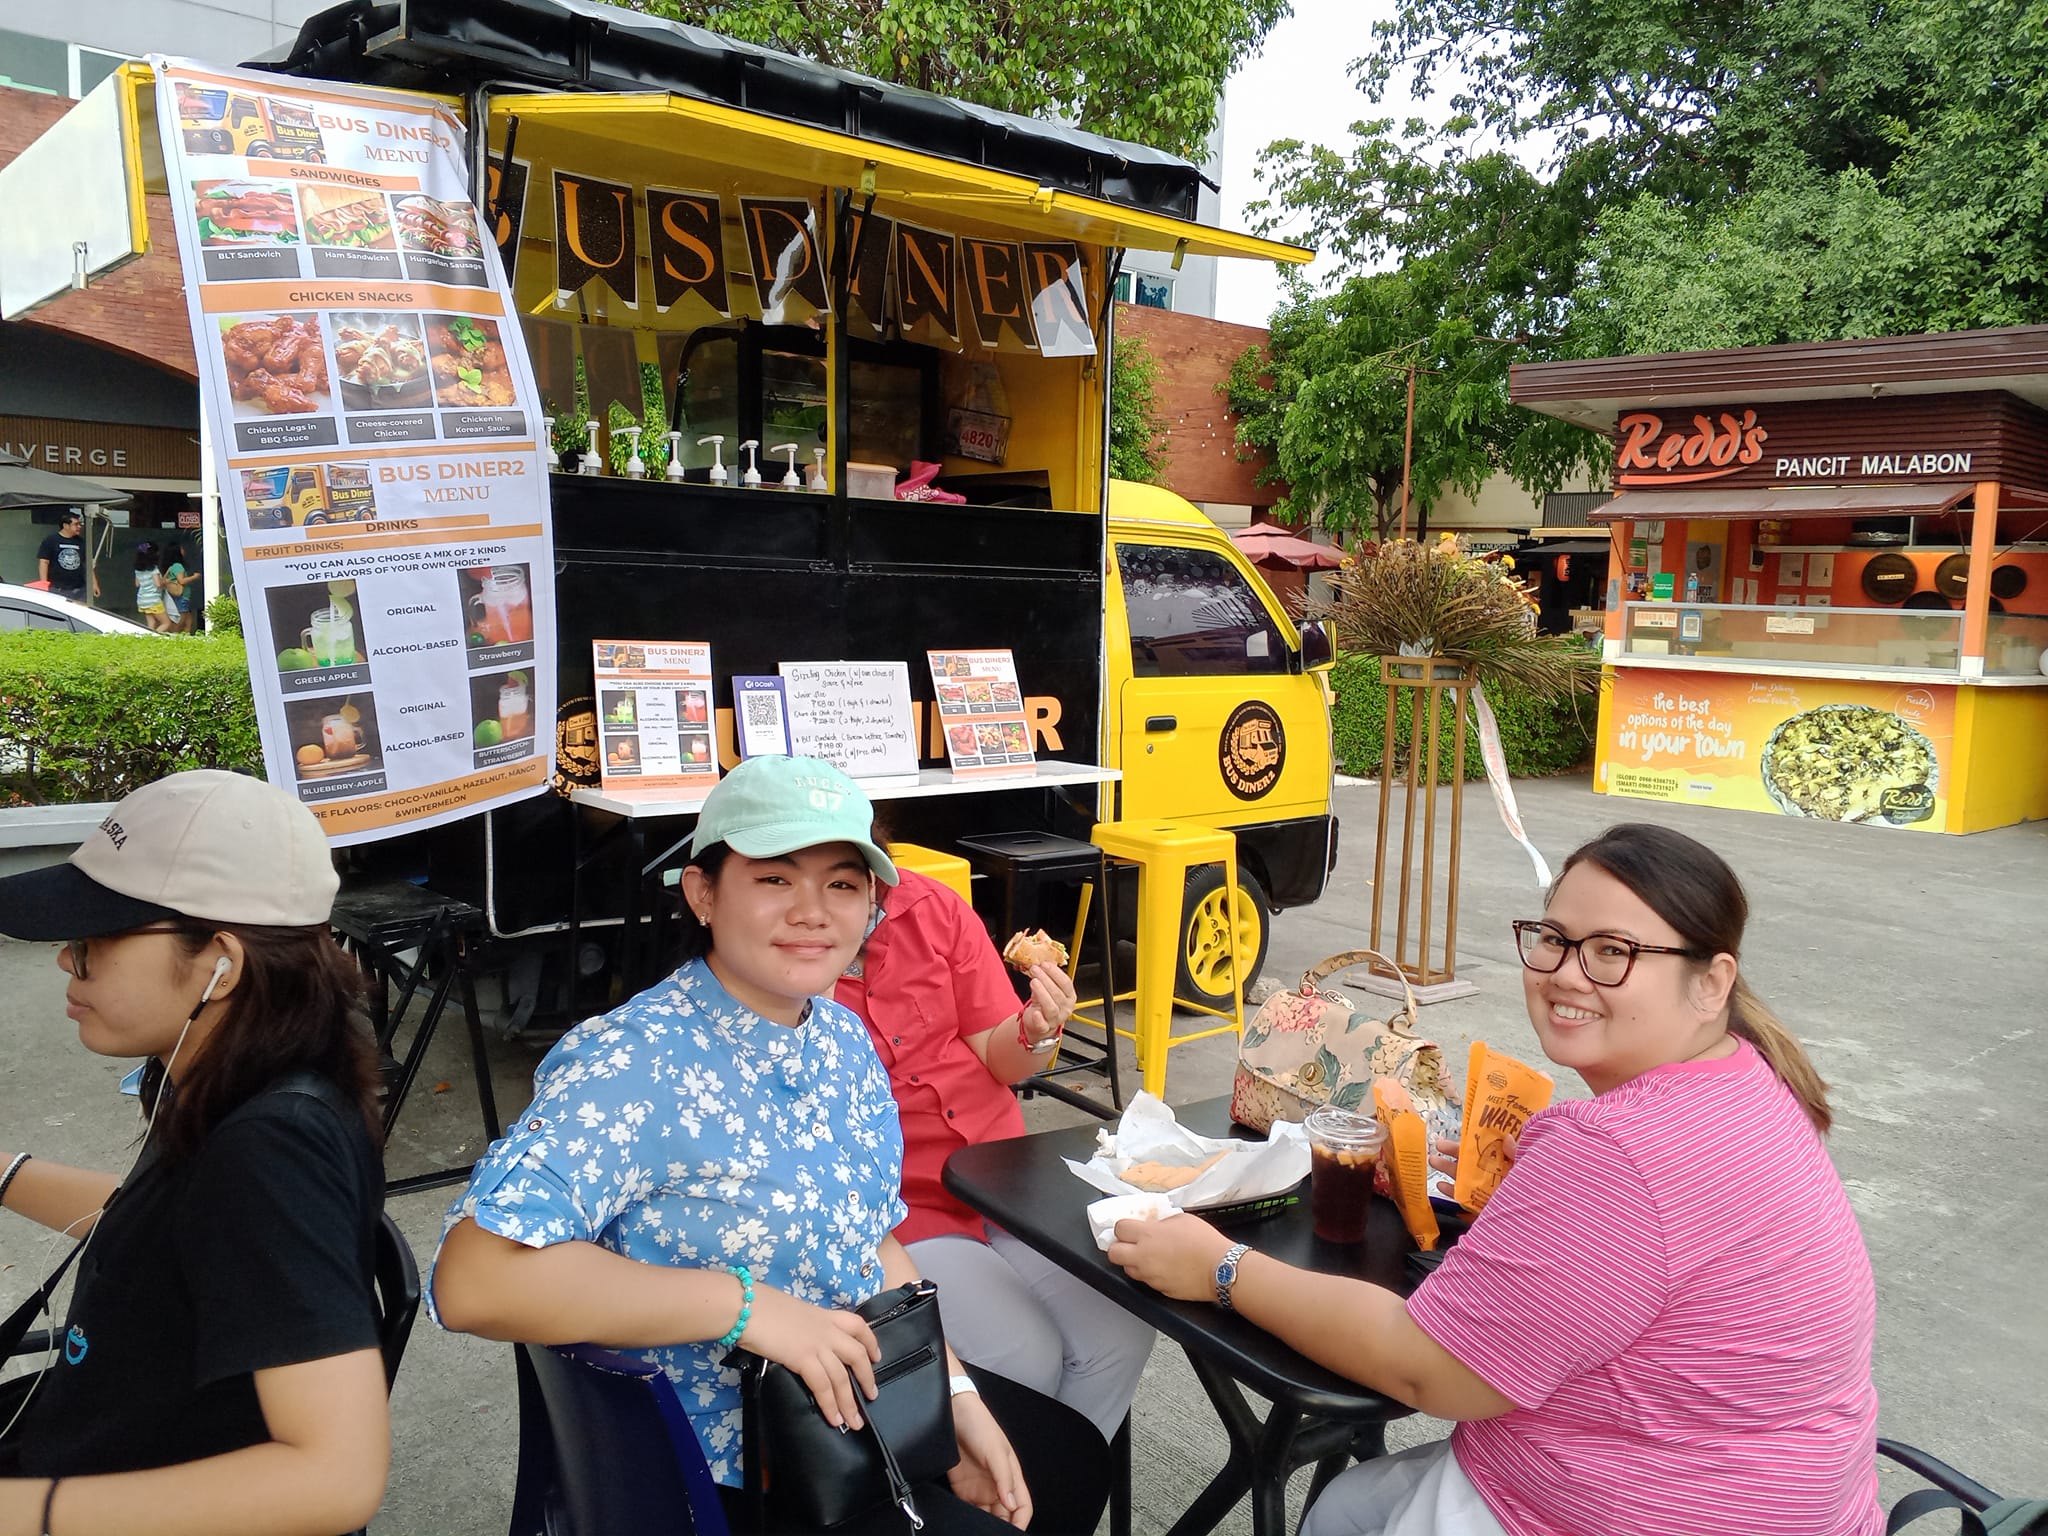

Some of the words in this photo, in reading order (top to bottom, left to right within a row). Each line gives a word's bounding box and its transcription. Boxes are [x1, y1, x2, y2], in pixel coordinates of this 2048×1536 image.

[276, 125, 295, 136] Bus
[296, 128, 320, 138] Diner
[318, 115, 369, 133] BUS
[364, 144, 429, 163] MENU
[290, 167, 381, 188] SANDWICHES
[237, 250, 281, 258] Sandwich
[410, 256, 449, 267] Hungarian
[289, 291, 355, 303] CHICKEN
[358, 291, 414, 303] SNACKS
[356, 417, 423, 428] Cheese-covered
[461, 415, 492, 423] Chicken
[494, 414, 503, 422] in
[247, 425, 284, 435] Chicken
[287, 423, 306, 435] Legs
[308, 423, 317, 431] in
[374, 429, 409, 438] Chicken
[455, 425, 484, 433] Korean
[487, 424, 511, 432] Sauce
[260, 435, 280, 445] BBQ
[282, 433, 310, 443] Sauce
[1618, 409, 1768, 470] Redd's
[378, 464, 431, 483] BUS
[439, 460, 526, 480] DINER2
[1775, 456, 1850, 478] PANCIT
[1861, 453, 1972, 475] MALABON
[331, 490, 349, 500] Bus
[351, 489, 372, 498] Diner
[424, 485, 490, 504] MENU
[366, 519, 418, 533] DRINKS
[255, 546, 291, 557] FRUIT
[320, 559, 343, 569] CAN
[346, 556, 375, 566] ALSO
[377, 552, 422, 563] CHOOSE
[434, 549, 452, 558] MIX
[454, 548, 468, 557] OF
[469, 548, 475, 556] 2
[478, 545, 506, 555] KINDS
[307, 572, 321, 581] OF
[324, 567, 372, 579] FLAVORS
[374, 565, 388, 574] OF
[391, 563, 419, 573] YOUR
[421, 561, 446, 570] OWN
[386, 604, 436, 617] ORIGINAL
[372, 639, 458, 657] ALCOHOL-BASED
[479, 649, 522, 662] Strawberry
[670, 648, 705, 656] DINER2
[295, 674, 326, 686] GREEN
[329, 671, 358, 682] APPLE
[399, 701, 446, 715] ORIGINAL
[1653, 692, 1674, 712] the
[1679, 695, 1710, 715] best
[1628, 713, 1667, 729] options
[1671, 716, 1682, 731] of
[1685, 713, 1704, 730] the
[1708, 716, 1731, 737] day
[385, 731, 465, 753] ALCOHOL-BASED
[1619, 725, 1636, 749] in
[1641, 732, 1691, 761] your
[1693, 731, 1744, 759] town
[1223, 755, 1239, 784] BUS
[302, 777, 384, 796] BLUEBERRY-APPLE
[330, 802, 382, 817] FLAVORS:
[384, 785, 462, 808] CHOCO-VANILLA,
[463, 773, 508, 790] HAZELNUT,
[508, 765, 536, 778] MANGO
[395, 794, 466, 818] &WINTERMELON
[1883, 790, 1933, 807] Redd's
